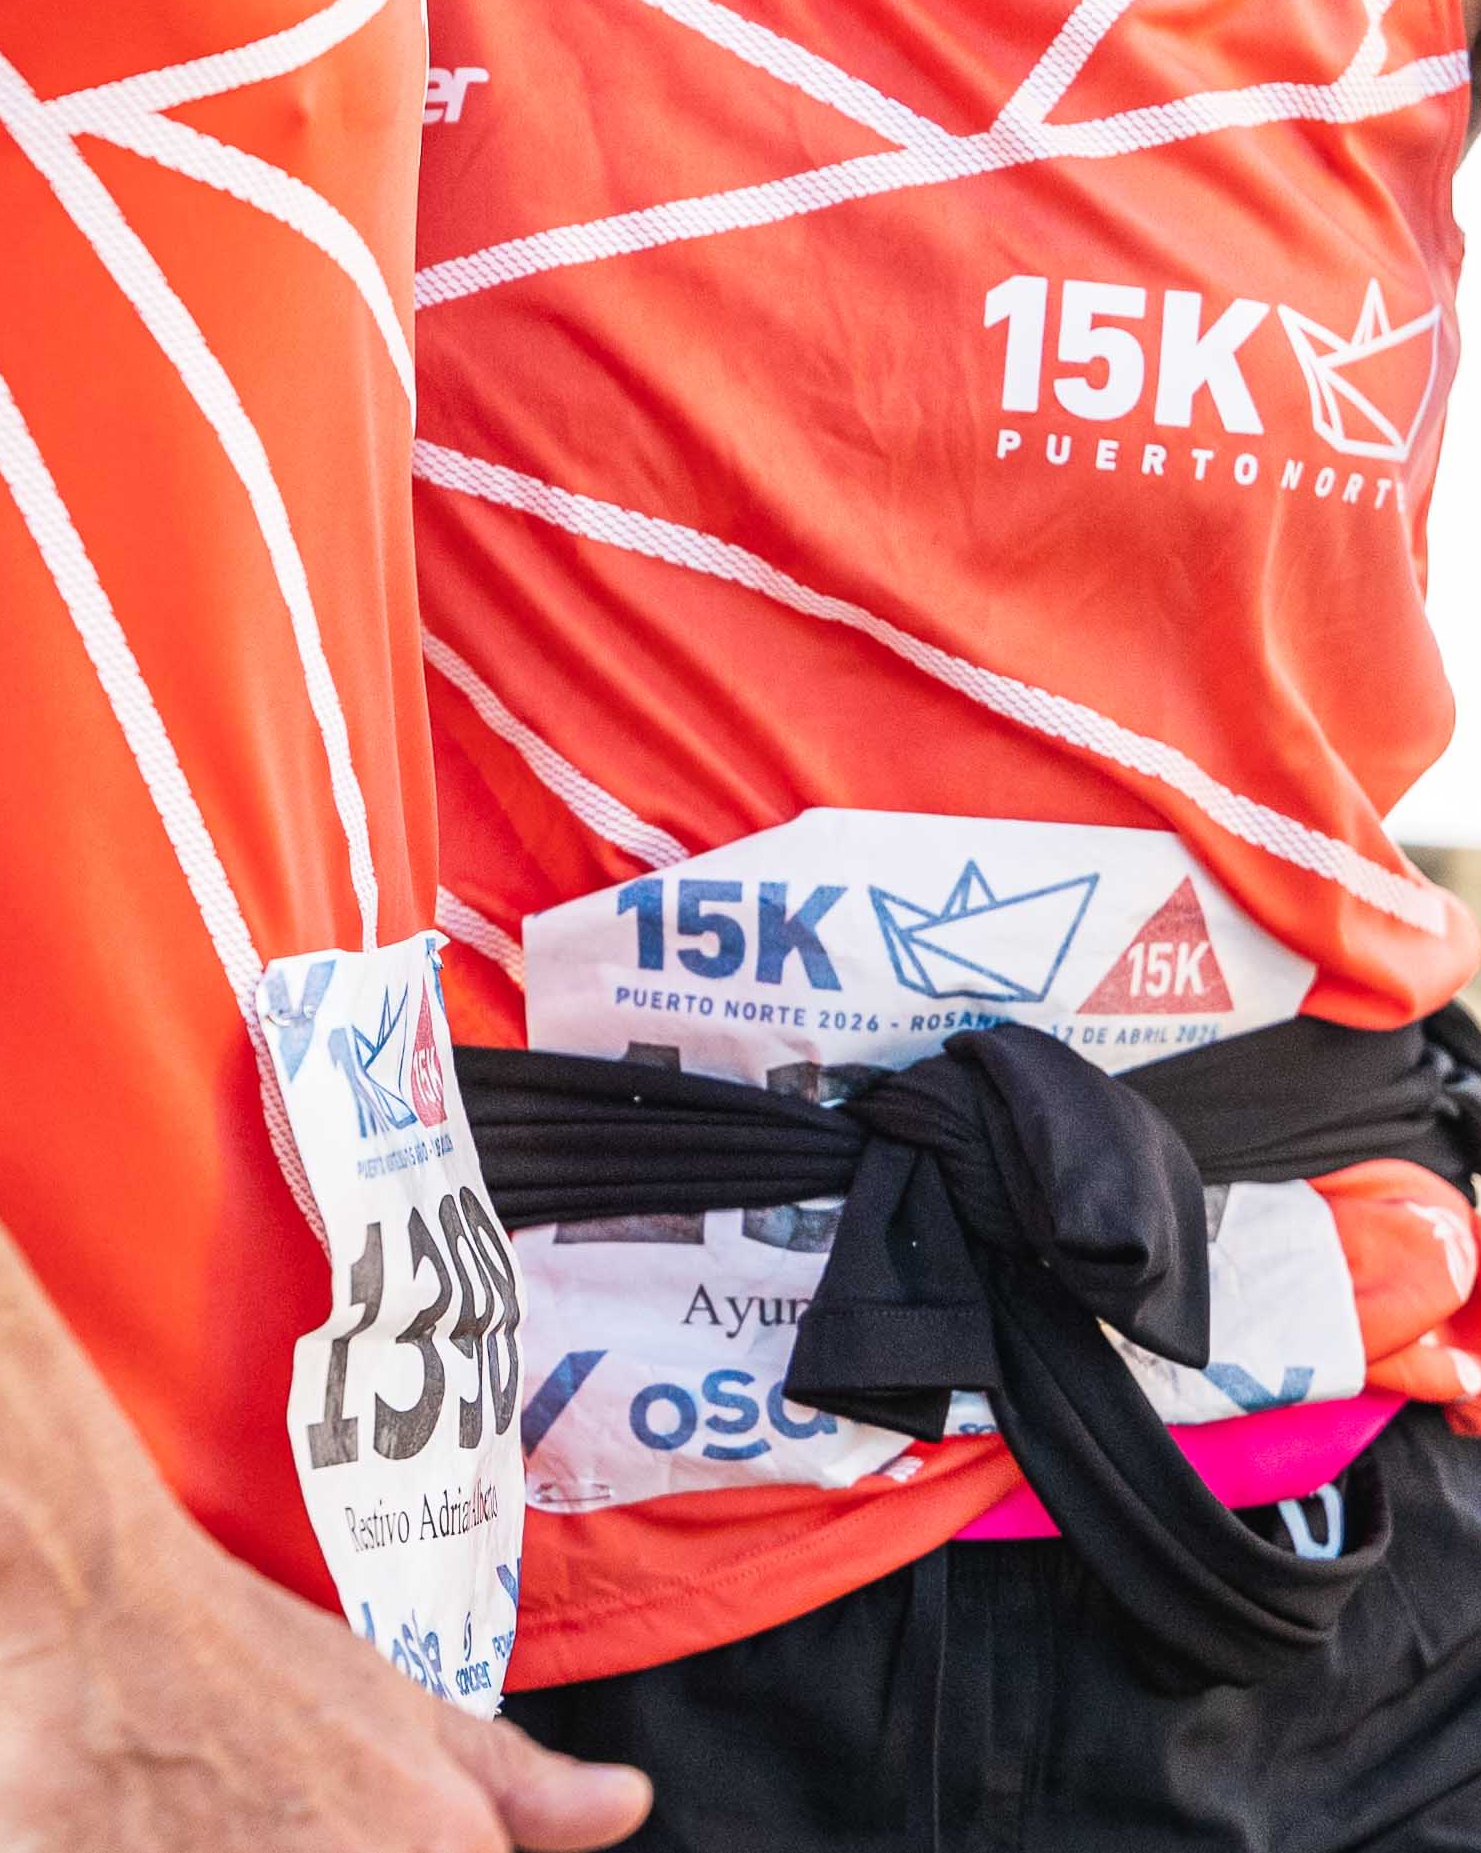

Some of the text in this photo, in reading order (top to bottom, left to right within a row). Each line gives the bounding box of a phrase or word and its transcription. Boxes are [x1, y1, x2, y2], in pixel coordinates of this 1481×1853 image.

[982, 274, 1271, 436] 15K
[997, 428, 1261, 486] PUERTO
[616, 878, 848, 992] 15K
[1126, 940, 1211, 998] 15K
[616, 986, 714, 1016] PUERTO
[723, 999, 806, 1027] NORTE
[817, 1010, 880, 1033] 2026
[1081, 1026, 1108, 1045] DE
[1114, 1026, 1168, 1045] ABRIL
[306, 1186, 520, 1469] 1398
[344, 1498, 411, 1553] Restivo
